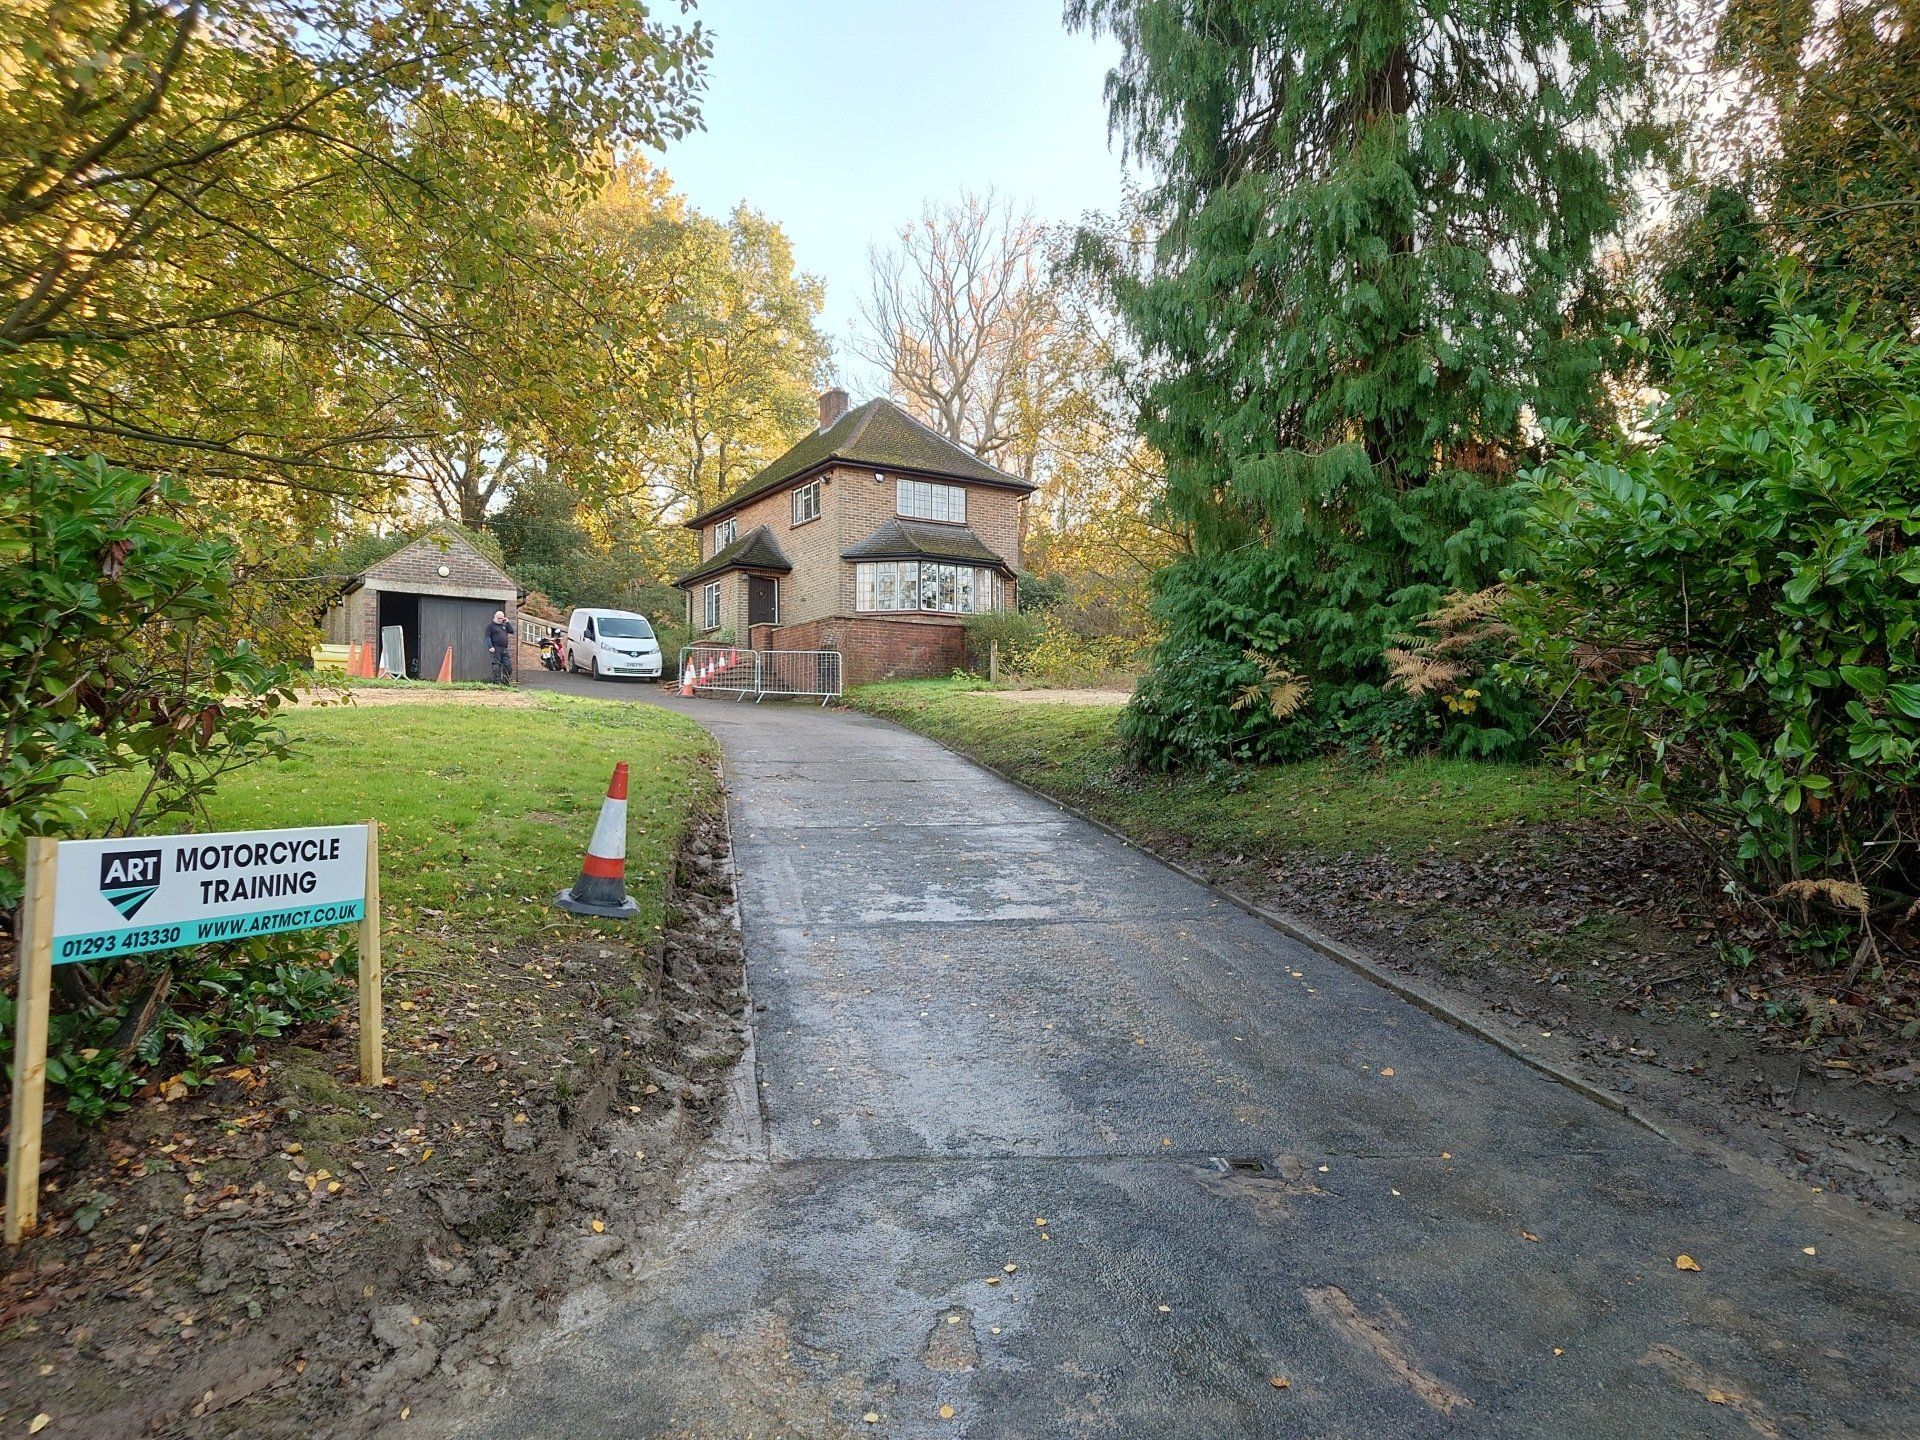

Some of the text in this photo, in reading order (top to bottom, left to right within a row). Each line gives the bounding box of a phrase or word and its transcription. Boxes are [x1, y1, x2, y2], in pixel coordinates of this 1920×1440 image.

[104, 856, 158, 884] ART
[175, 838, 340, 873] MOTORCYCLE
[200, 870, 318, 905] TRAINING
[198, 904, 357, 939] WWW.ARTMCT.CO.UK
[62, 926, 181, 958] 01293 413330
